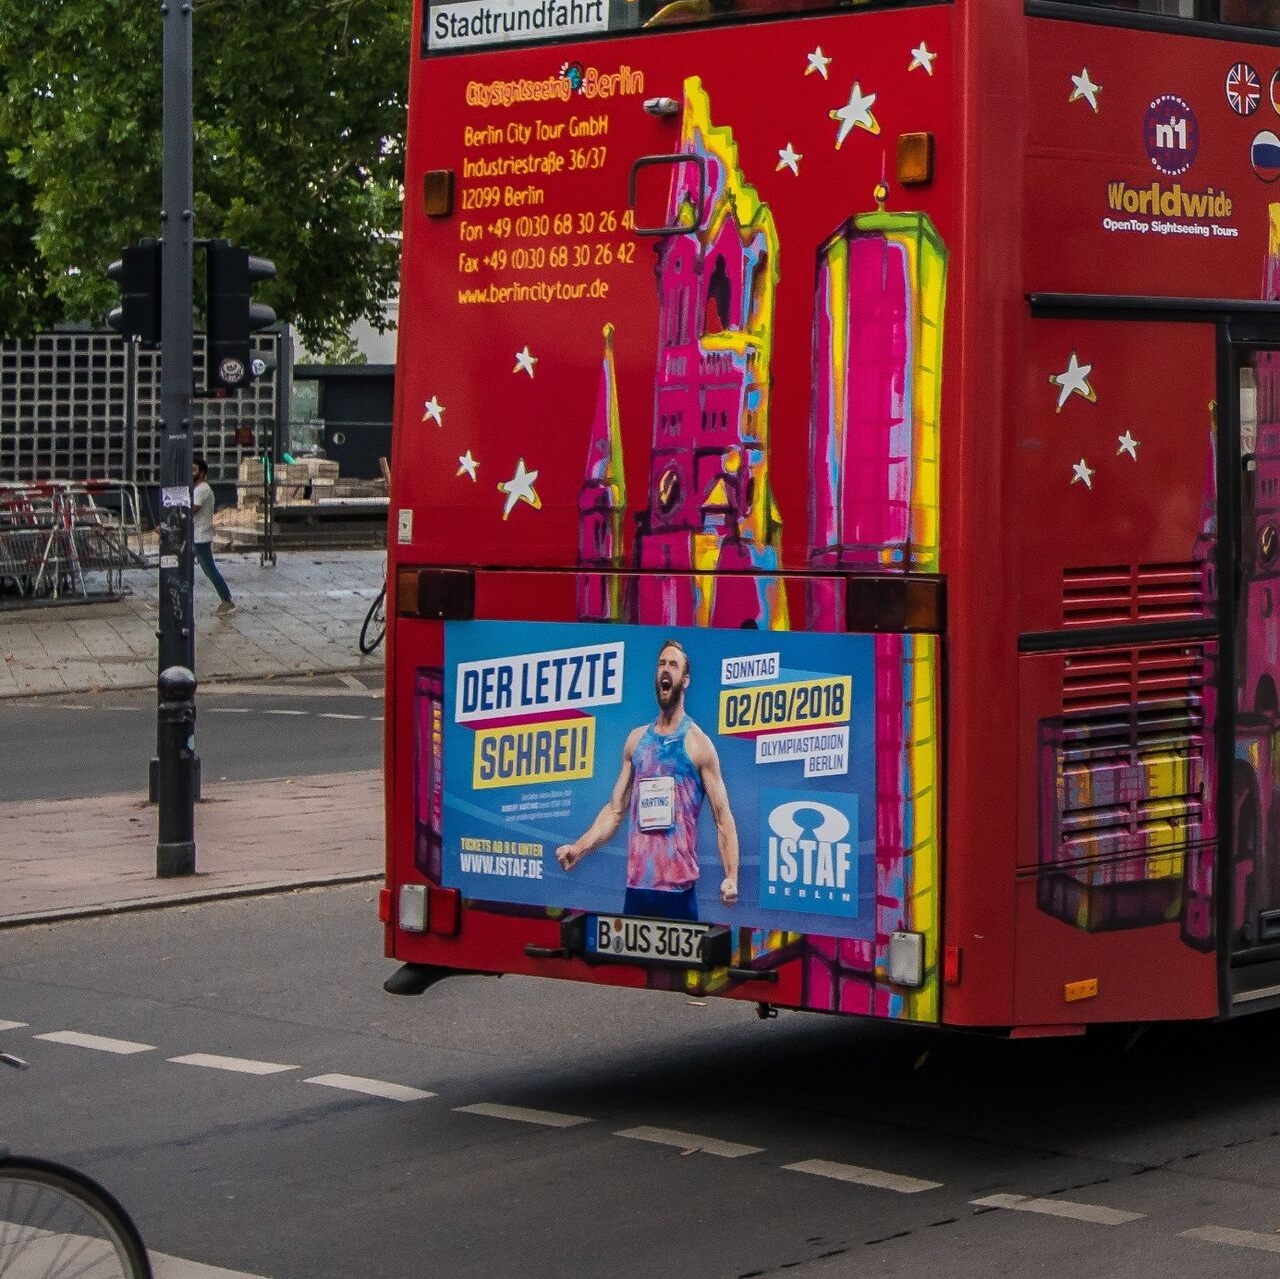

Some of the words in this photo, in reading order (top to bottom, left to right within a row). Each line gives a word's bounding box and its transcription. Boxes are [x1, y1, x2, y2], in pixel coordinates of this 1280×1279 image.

[585, 65, 644, 99] Berlin
[465, 126, 503, 146] Berlin
[507, 122, 531, 144] City
[535, 120, 565, 140] Tour
[570, 115, 608, 137] GmbH
[463, 151, 564, 177] Industriestraße
[569, 147, 607, 170] 36/37
[463, 187, 500, 209] 12099
[505, 186, 544, 206] Berlin
[1108, 182, 1232, 218] Worldwide
[460, 222, 483, 241] Fon
[488, 218, 511, 238] +49
[516, 215, 549, 237] (0)30
[554, 213, 572, 235] 68
[577, 212, 594, 234] 30
[600, 211, 617, 232] 26
[1151, 221, 1209, 237] Sightseeing
[1212, 225, 1238, 237] Tours
[459, 253, 478, 272] Fax
[484, 250, 507, 270] +49
[512, 247, 545, 269] (0)30
[550, 246, 568, 267] 68
[573, 245, 590, 266] 30
[595, 244, 612, 265] 26
[617, 242, 635, 263] 42
[458, 278, 608, 304] www.berlincitytour.de
[463, 666, 513, 713] DER
[521, 651, 617, 706] LETZTE
[726, 658, 775, 679] SONNTAG
[726, 683, 844, 727] 02/09/2018
[480, 726, 588, 780] SCHREI!
[761, 734, 843, 756] OLYMPIASTADION
[809, 754, 843, 771] BERLIN
[460, 853, 543, 879] WWW.ISTAF.DE
[769, 837, 851, 888] ISTAF
[769, 886, 850, 901] BERLIN
[599, 921, 611, 949] B
[625, 923, 651, 953] US
